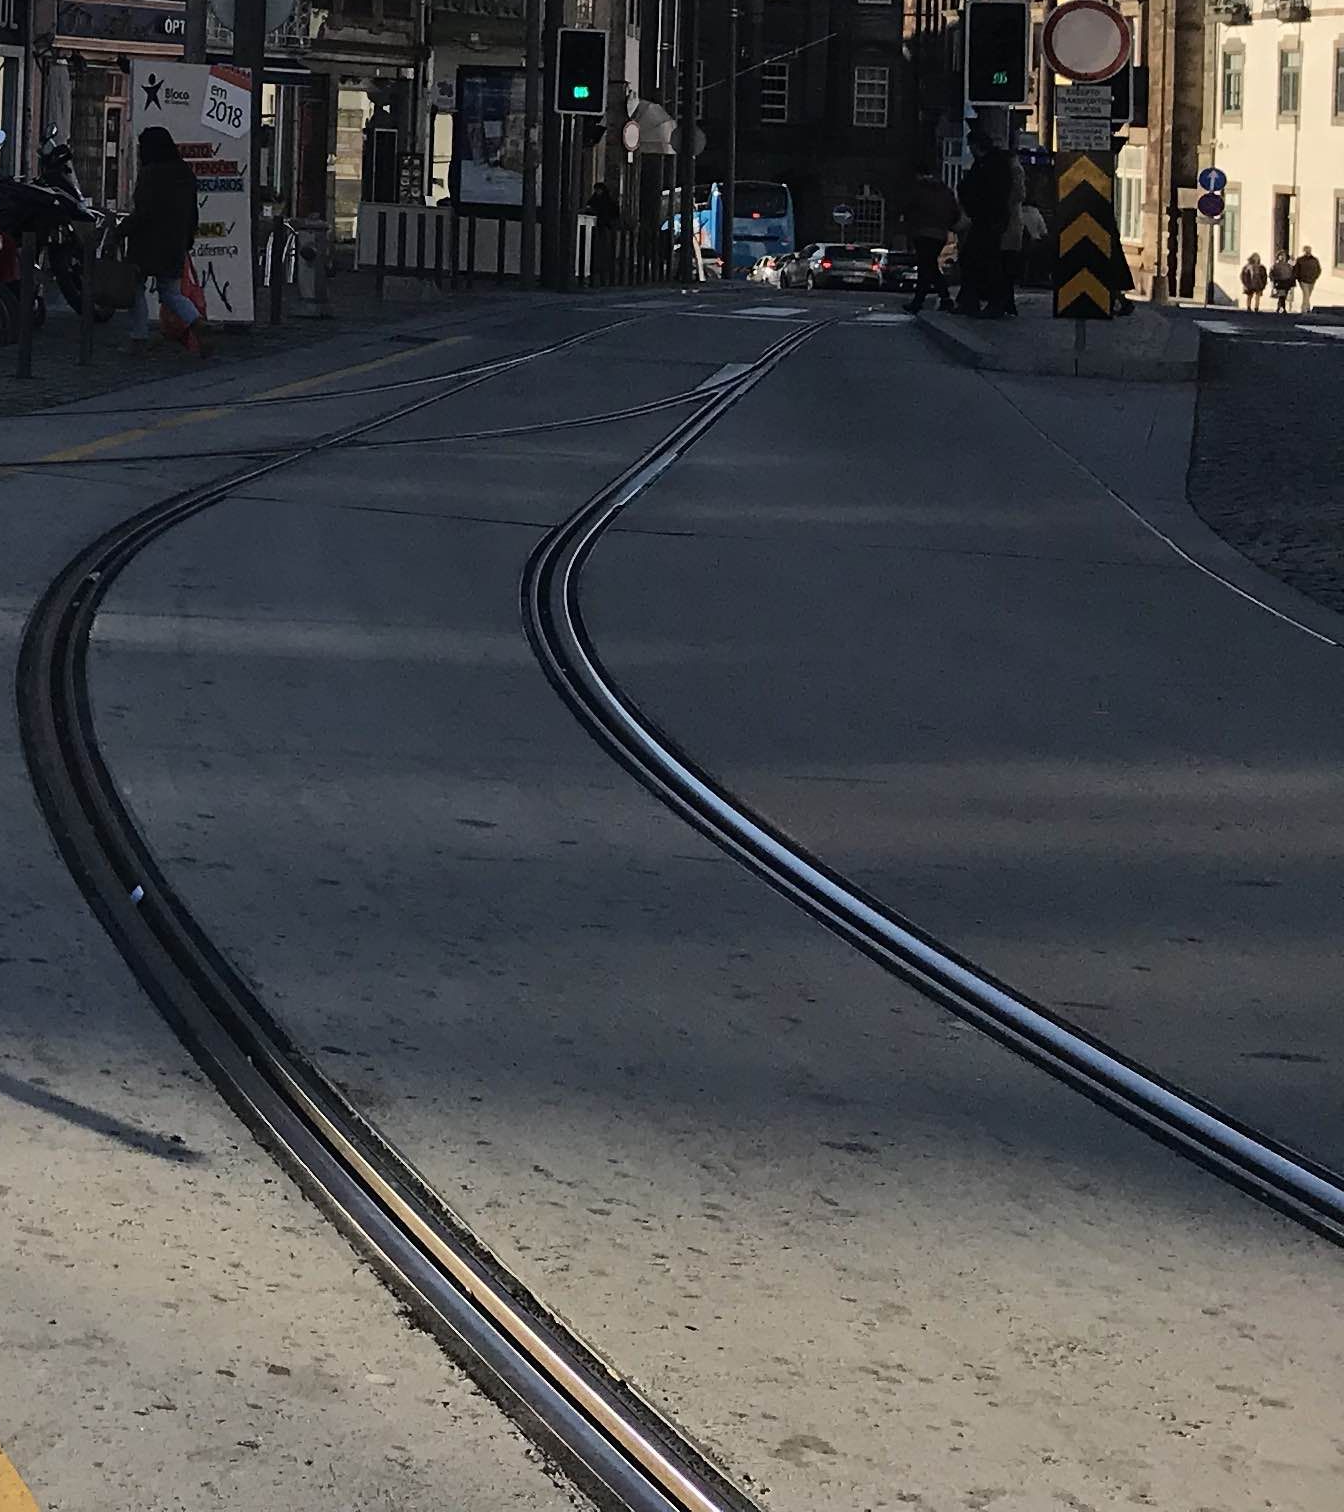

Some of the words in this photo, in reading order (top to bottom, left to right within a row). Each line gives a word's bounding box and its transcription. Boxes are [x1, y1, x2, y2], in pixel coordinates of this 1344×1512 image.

[164, 15, 185, 35] ÓPT
[164, 88, 190, 101] Bloco
[211, 85, 228, 100] em
[206, 97, 243, 129] 2018
